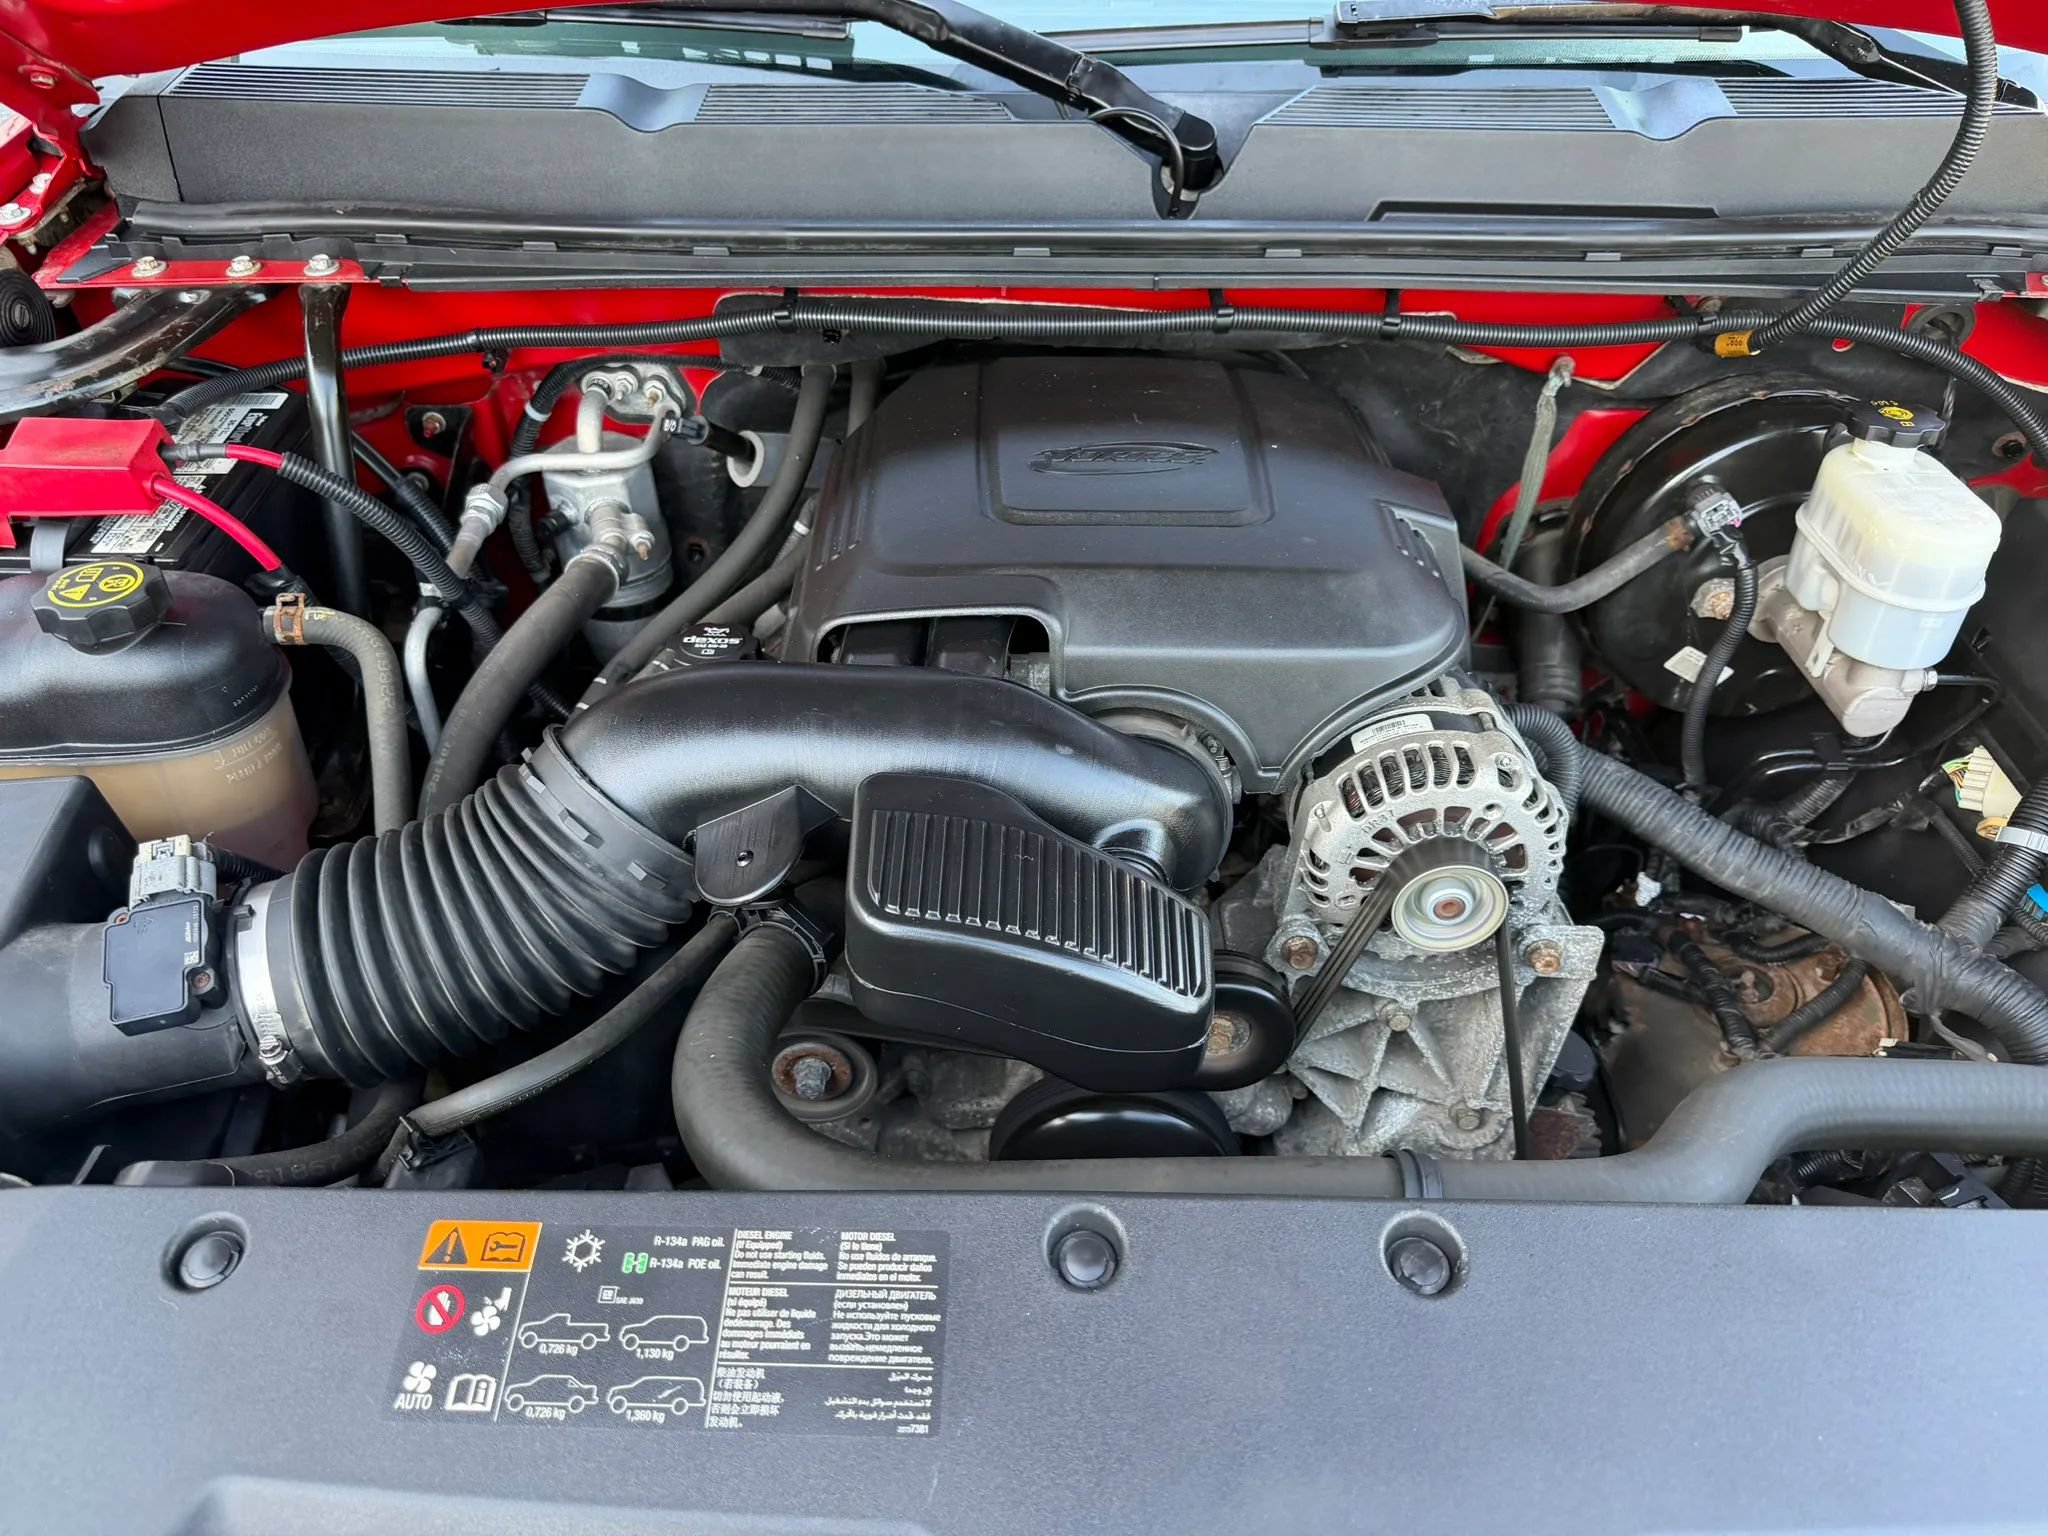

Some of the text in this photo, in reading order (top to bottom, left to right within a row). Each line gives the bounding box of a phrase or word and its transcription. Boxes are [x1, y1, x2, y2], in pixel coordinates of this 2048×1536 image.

[683, 636, 741, 644] dexos
[654, 1236, 725, 1247] R-134a PAG oil.
[650, 1259, 722, 1269] R-134a POE oil.
[539, 1344, 578, 1356] 0,726 kg
[636, 1348, 674, 1361] 1,130 kg
[394, 1394, 433, 1410] AUTO
[526, 1406, 566, 1420] 0,726 kg
[626, 1410, 665, 1423] 1,360 kg
